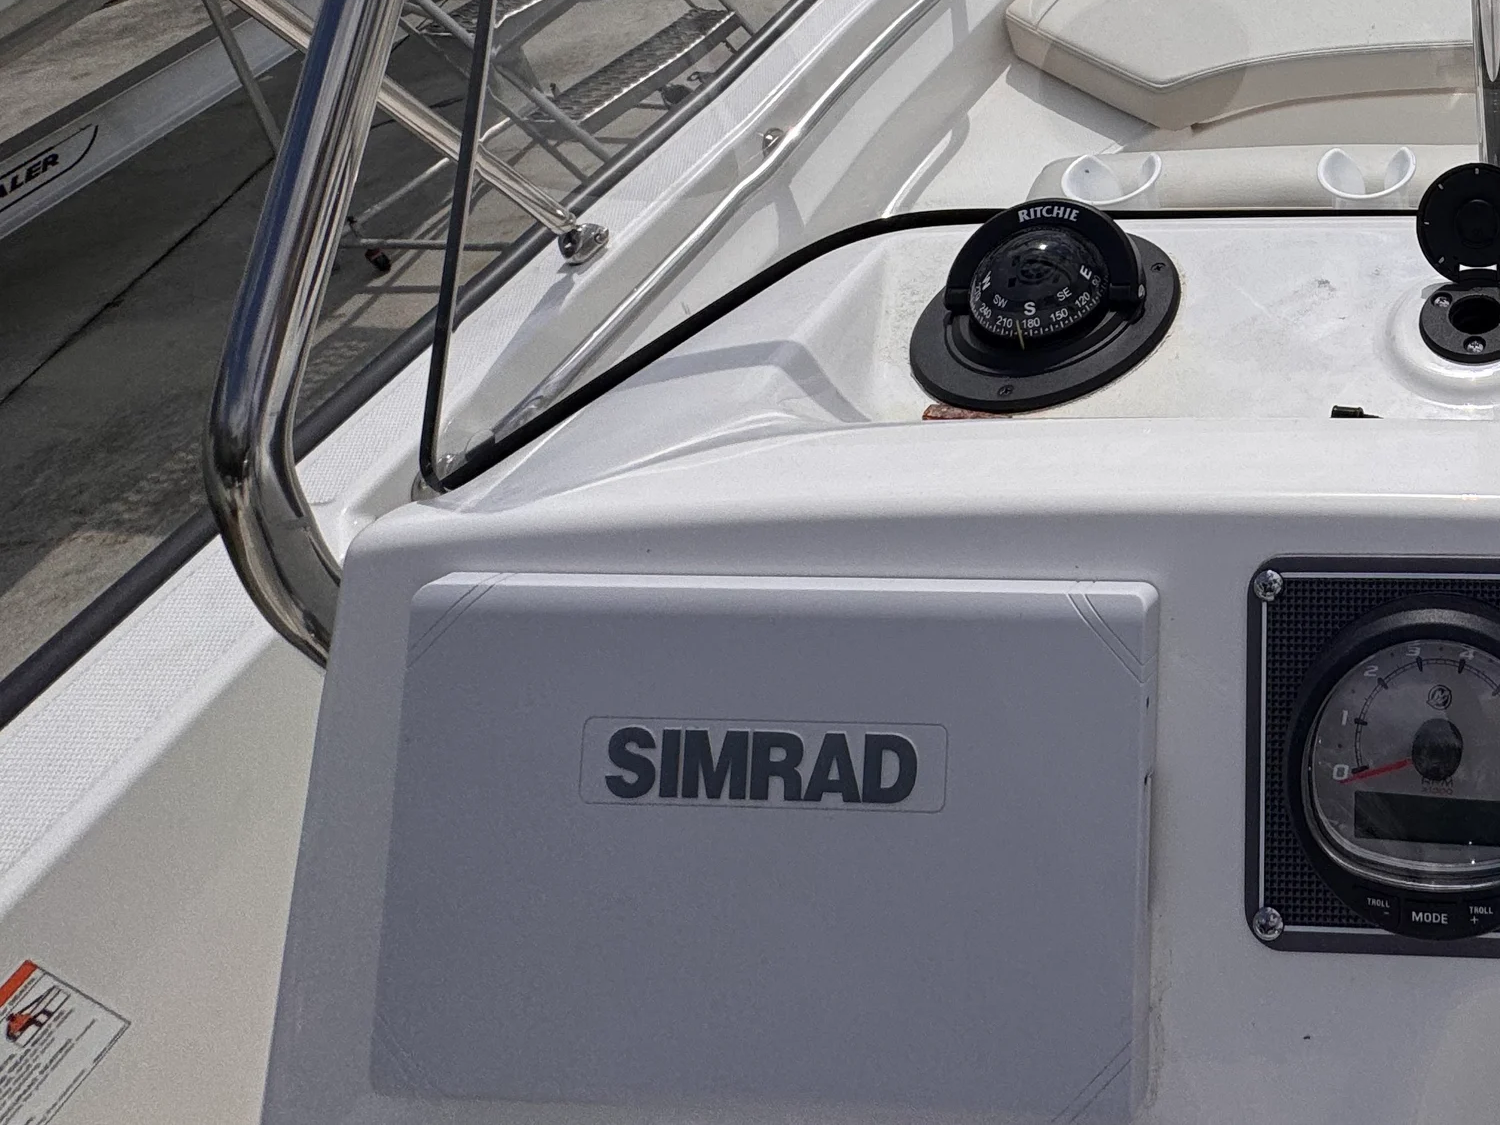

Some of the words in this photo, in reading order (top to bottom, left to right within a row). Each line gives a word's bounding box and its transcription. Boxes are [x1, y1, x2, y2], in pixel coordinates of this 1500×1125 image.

[1018, 206, 1079, 222] RITCHIE
[1080, 265, 1092, 280] E
[993, 294, 1008, 308] SW
[1057, 287, 1072, 301] SE
[1075, 292, 1091, 308] 120
[979, 303, 992, 319] 240
[1024, 302, 1036, 315] S
[1050, 308, 1068, 322] 150
[996, 316, 1013, 328] 210
[1022, 318, 1040, 329] 180
[1364, 665, 1378, 677] 2
[1341, 709, 1349, 725] 1
[604, 724, 918, 804] SIMRAD
[1332, 763, 1349, 781] 0
[1367, 897, 1390, 908] TROLL
[1411, 911, 1449, 924] MODE
[1469, 906, 1493, 915] TROLL
